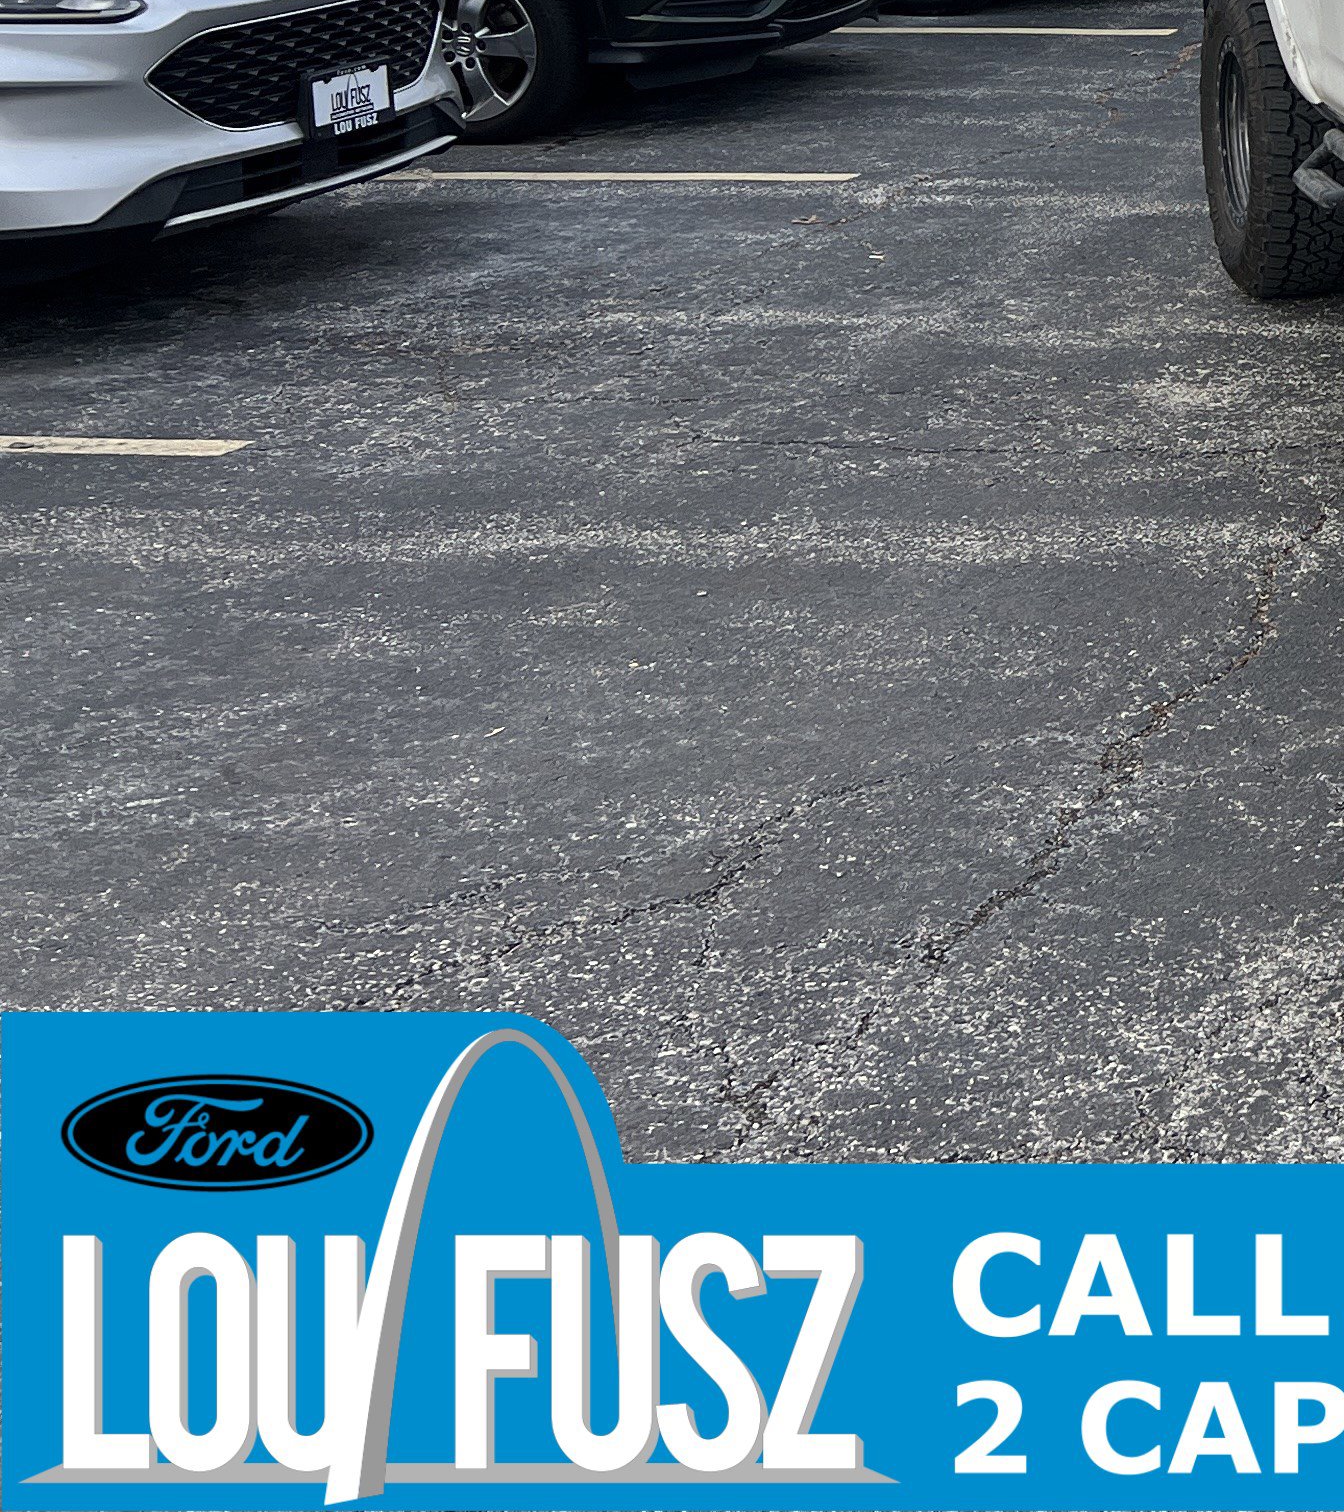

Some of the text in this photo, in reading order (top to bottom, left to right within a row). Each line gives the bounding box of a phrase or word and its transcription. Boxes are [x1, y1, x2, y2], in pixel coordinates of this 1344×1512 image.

[331, 90, 349, 111] LOU
[351, 84, 371, 107] FUSZ
[334, 113, 378, 135] LOU FUSZ
